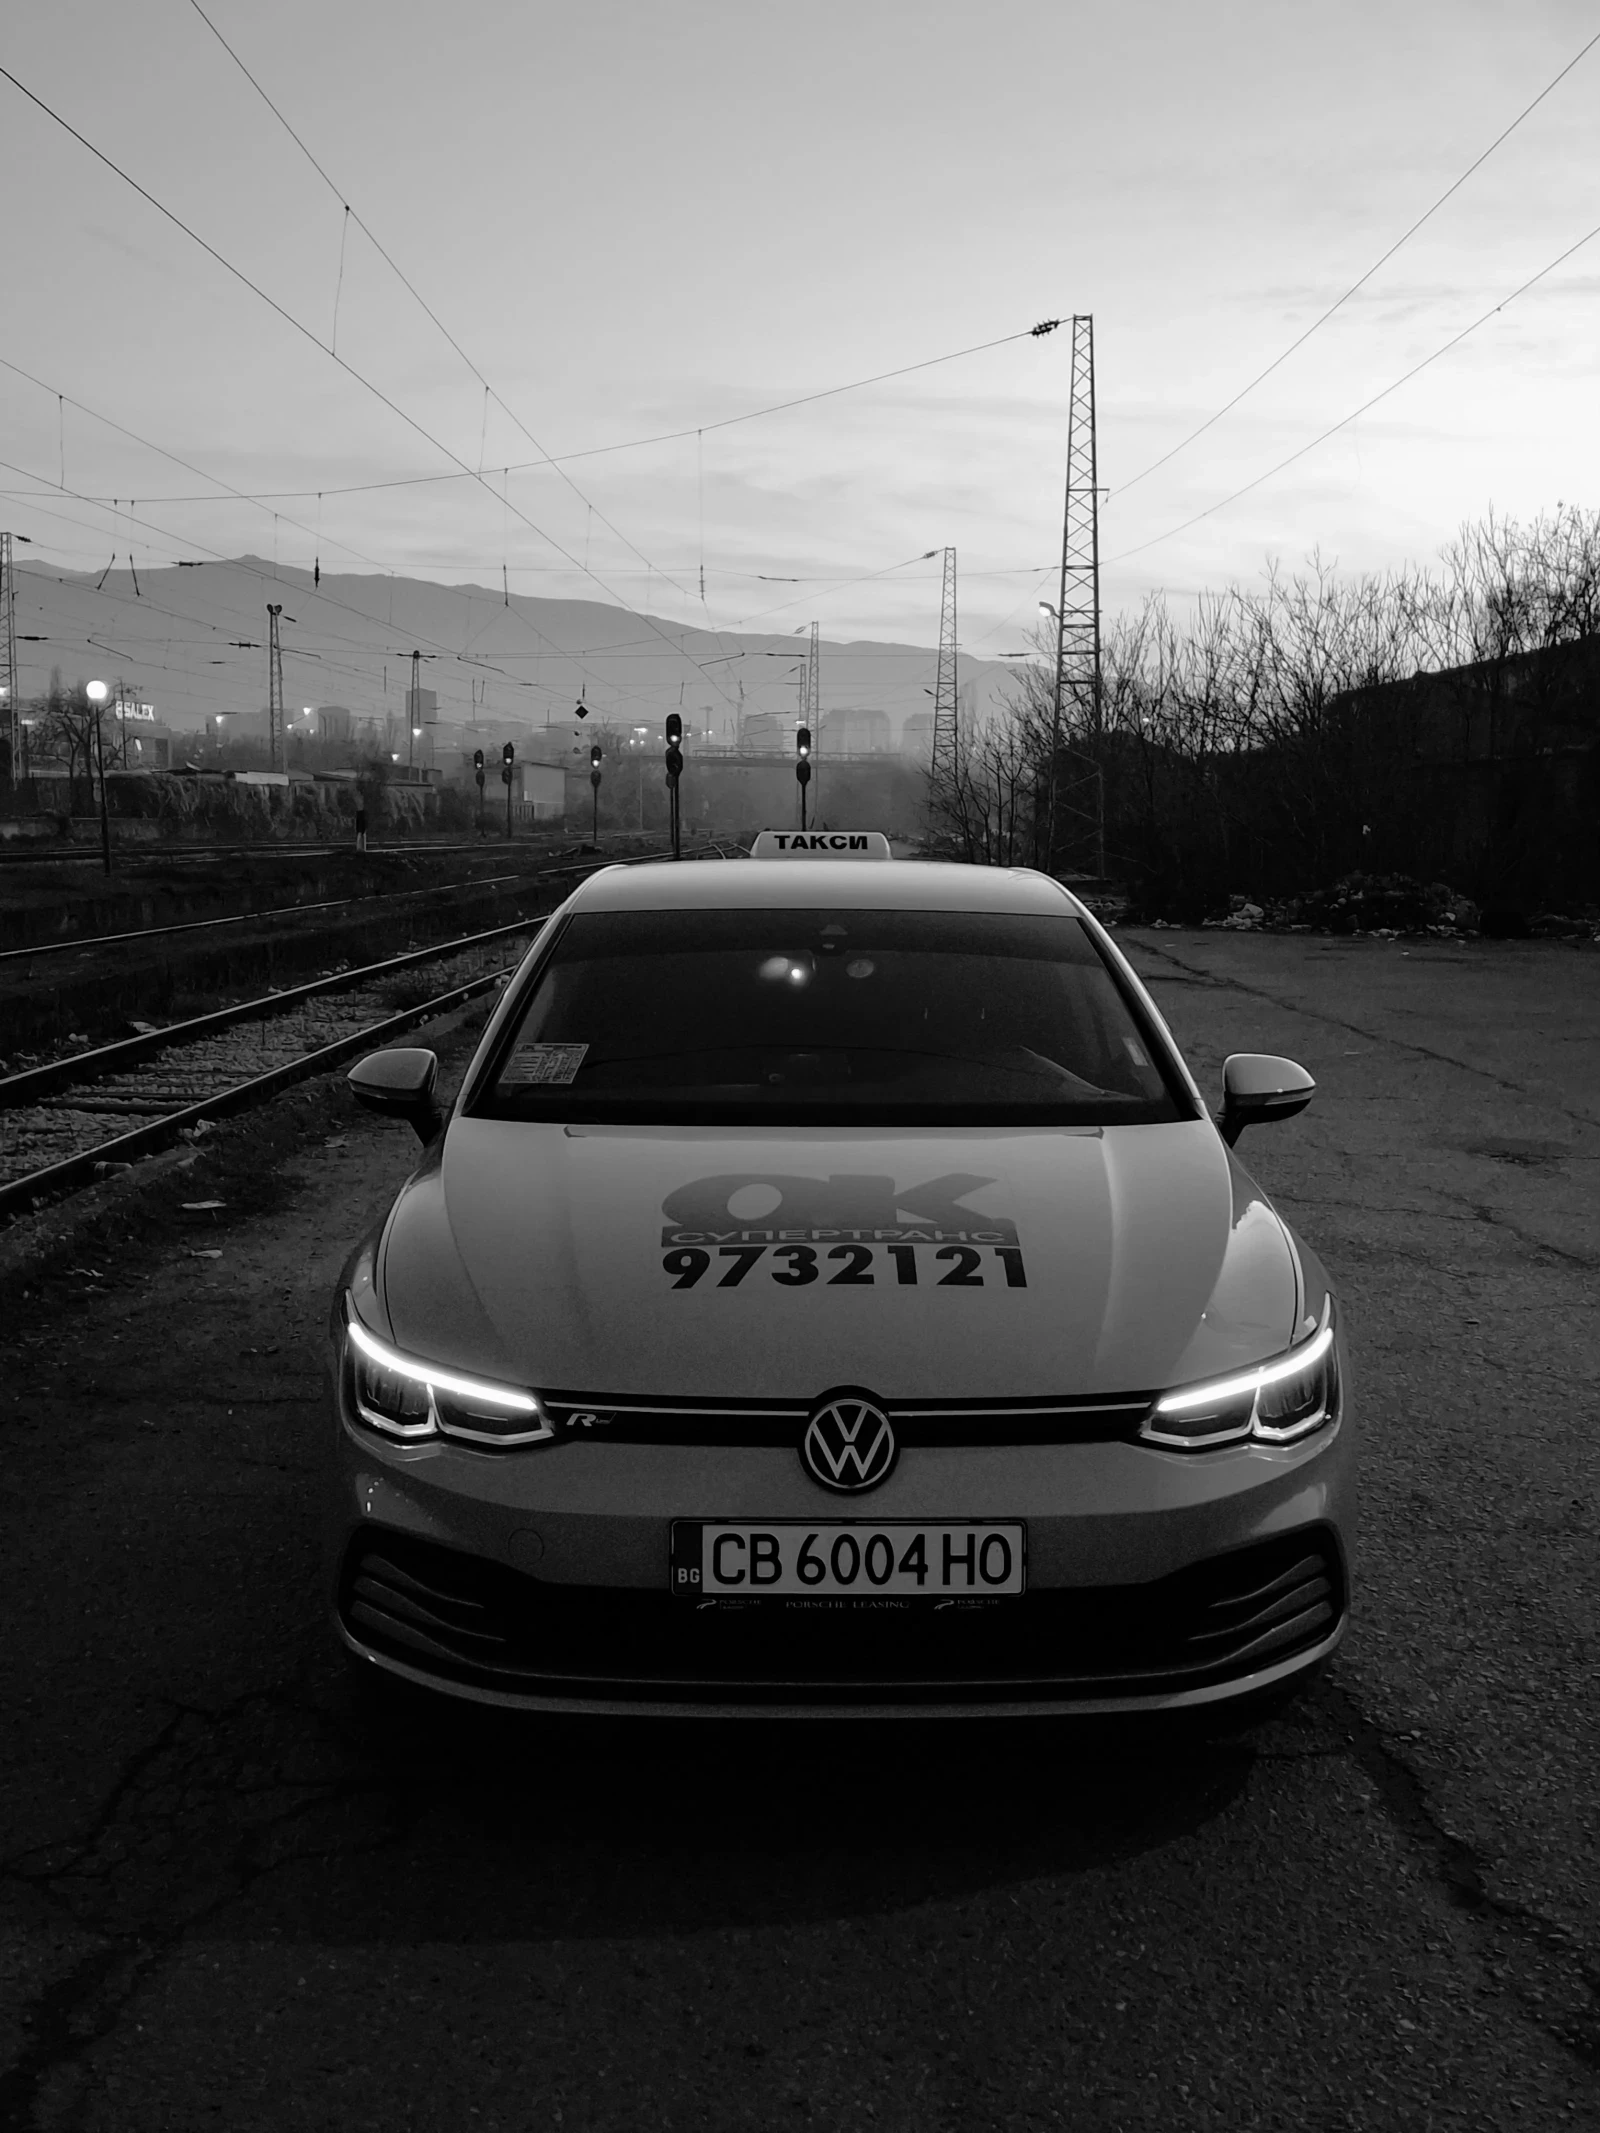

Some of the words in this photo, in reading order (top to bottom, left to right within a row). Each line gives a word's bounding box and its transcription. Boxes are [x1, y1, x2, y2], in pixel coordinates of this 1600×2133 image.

[774, 835, 868, 850] ТАКСИ
[670, 1228, 1006, 1243] СУПЕРТРАНС
[661, 1244, 1028, 1290] 9732121
[712, 1533, 783, 1585] CB
[796, 1533, 929, 1586] 6004
[942, 1533, 1012, 1585] HO
[677, 1568, 700, 1584] BG
[785, 1600, 848, 1609] PORSCHE
[852, 1600, 911, 1609] LEASING
